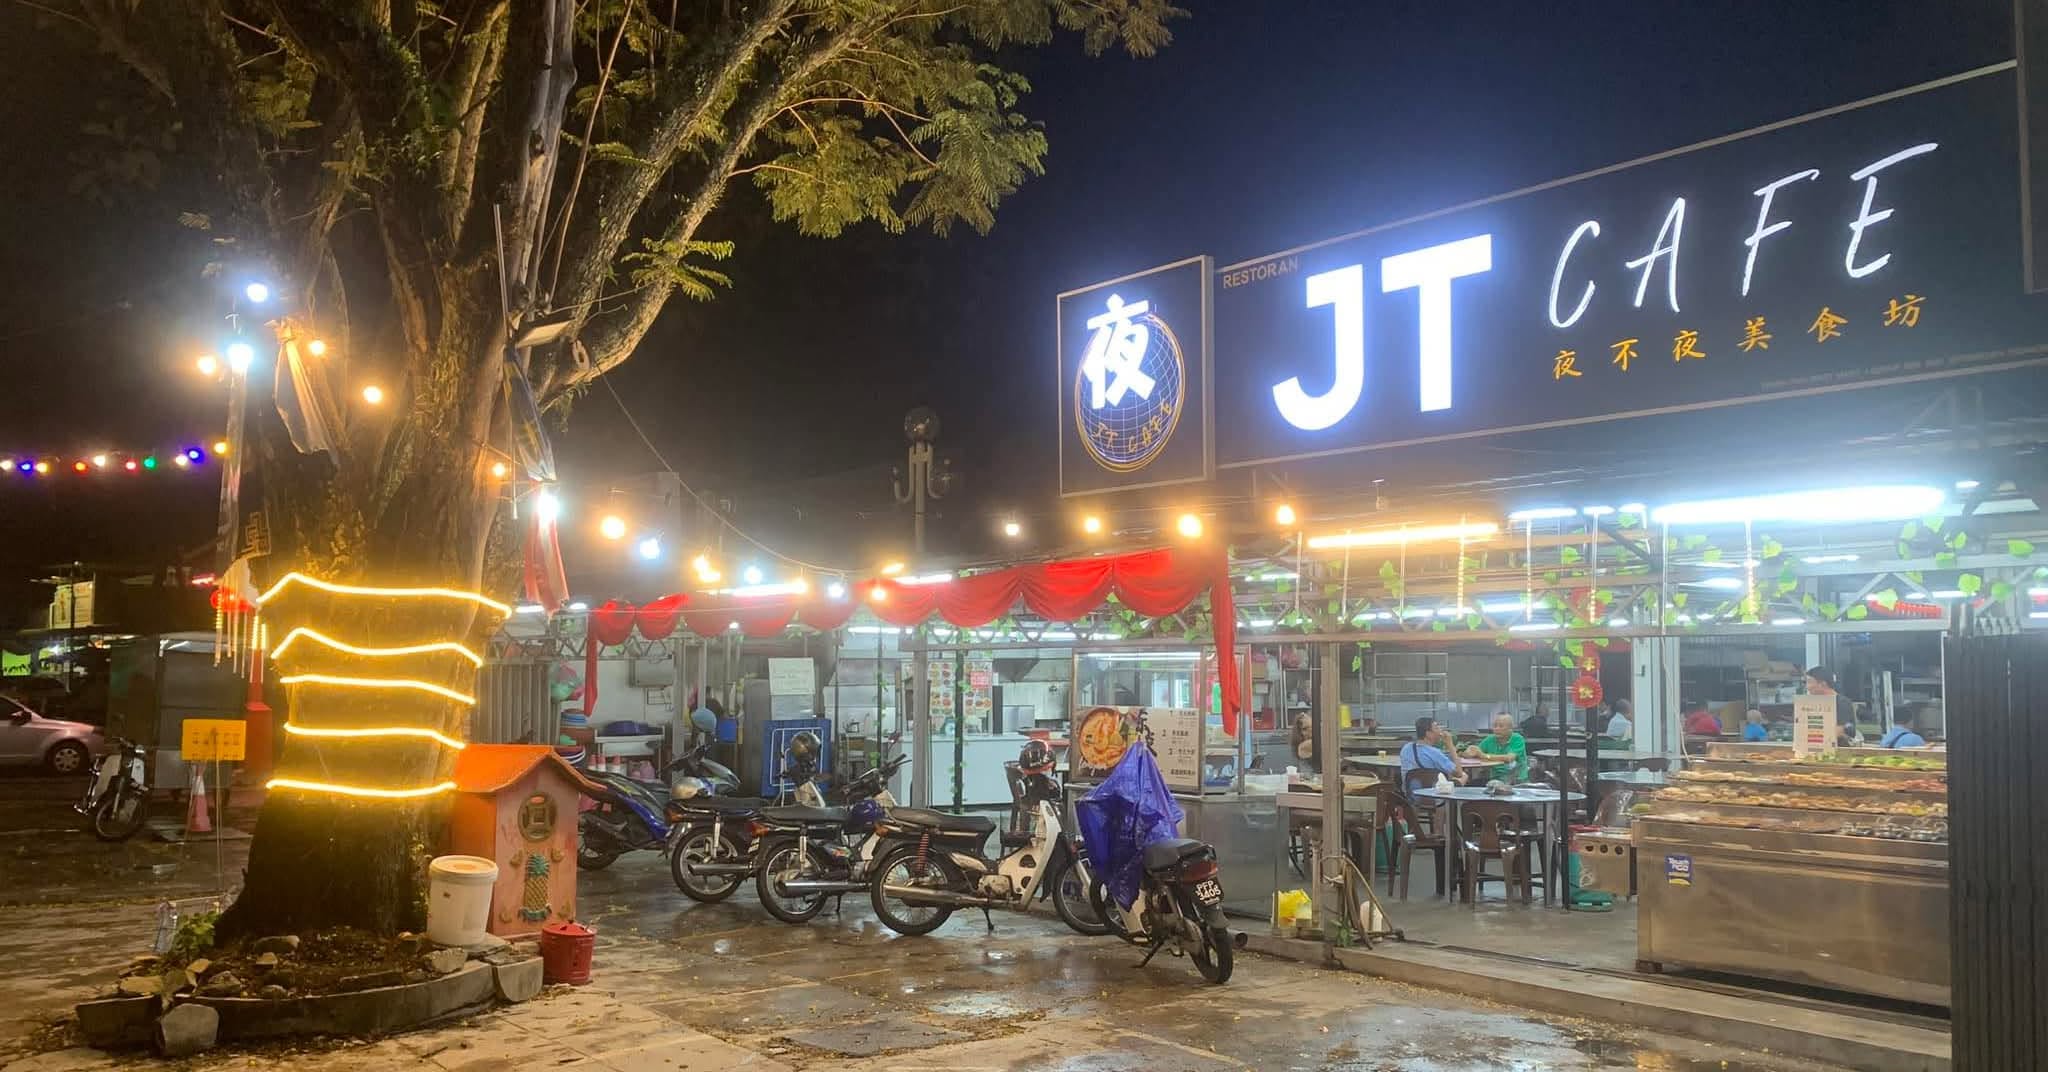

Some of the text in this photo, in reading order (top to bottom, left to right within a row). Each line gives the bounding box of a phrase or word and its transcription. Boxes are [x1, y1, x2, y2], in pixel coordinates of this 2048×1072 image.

[1222, 256, 1299, 289] RESTORAN
[1272, 142, 1939, 431] JT CAFE
[1082, 293, 1156, 409] 夜
[1552, 293, 1928, 380] 夜不夜美食坊
